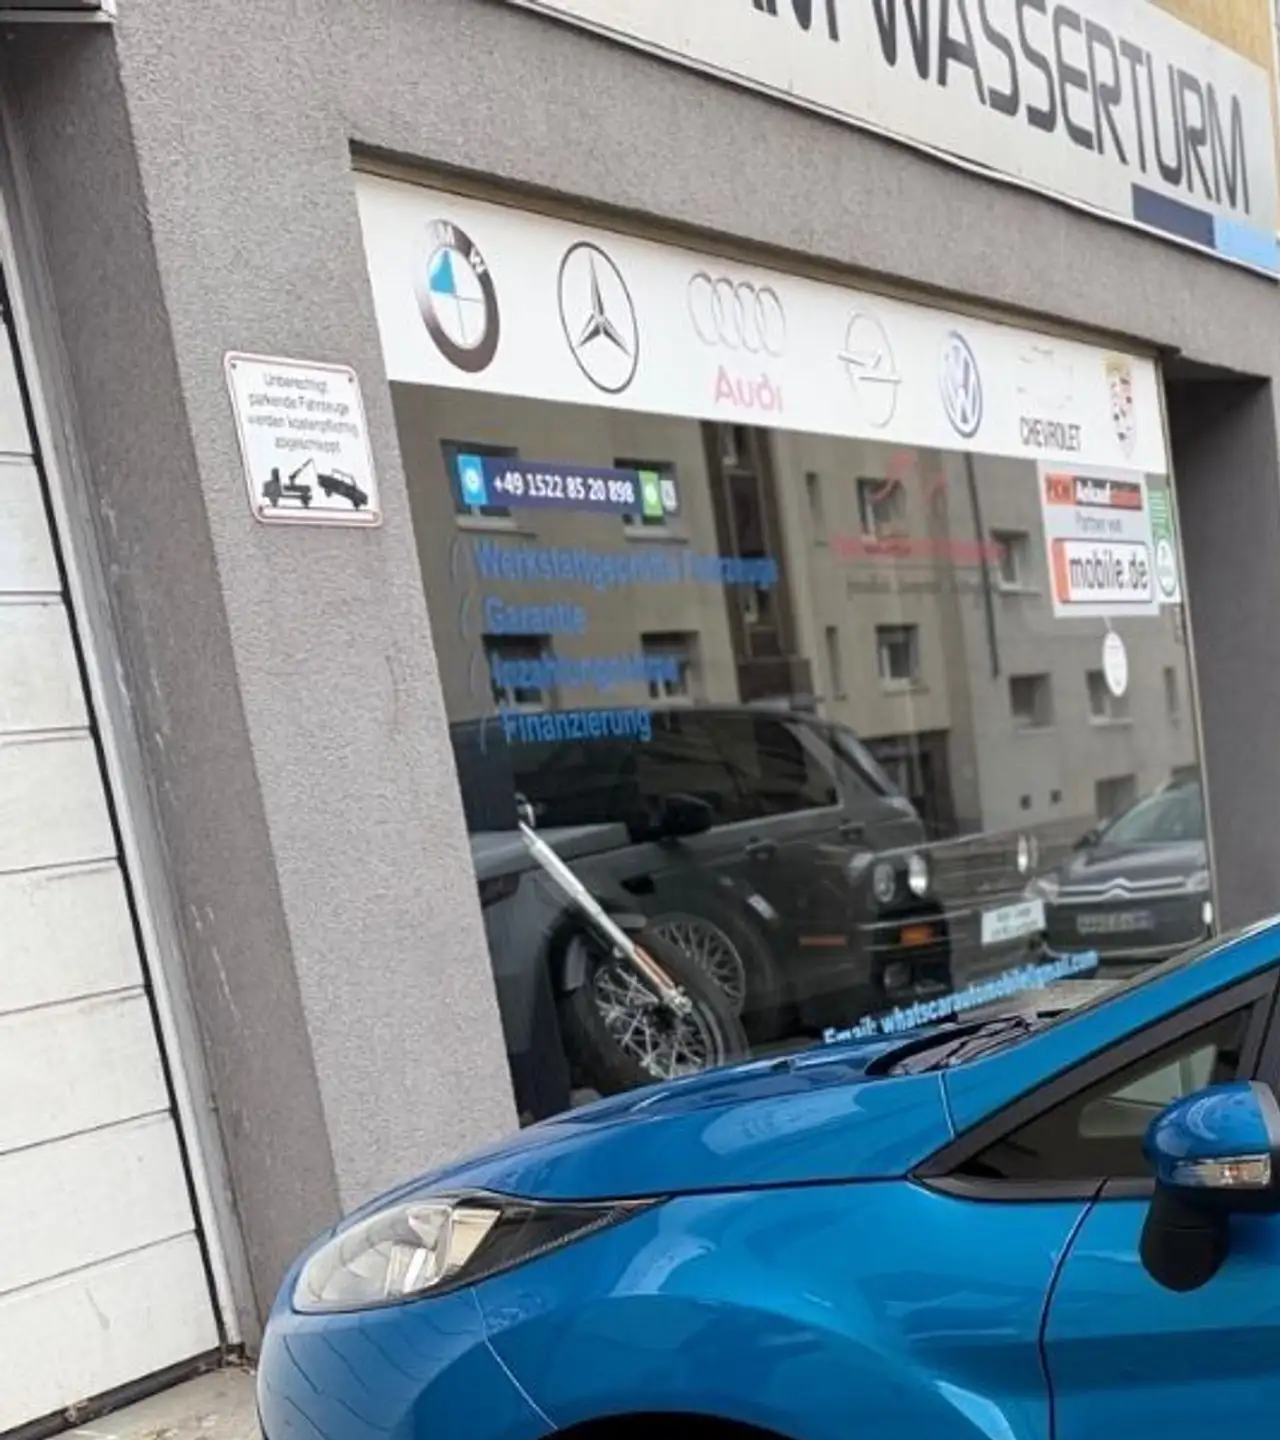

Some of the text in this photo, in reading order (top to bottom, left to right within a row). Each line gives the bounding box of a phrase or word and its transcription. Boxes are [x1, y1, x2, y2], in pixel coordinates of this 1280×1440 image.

[714, 364, 784, 414] Audi
[1020, 416, 1081, 451] CHEVROLET
[493, 471, 635, 504] +49 1522 85 20 898
[1069, 548, 1148, 591] mobile.de
[485, 596, 587, 635] Garantie
[503, 708, 651, 742] Finanzierung
